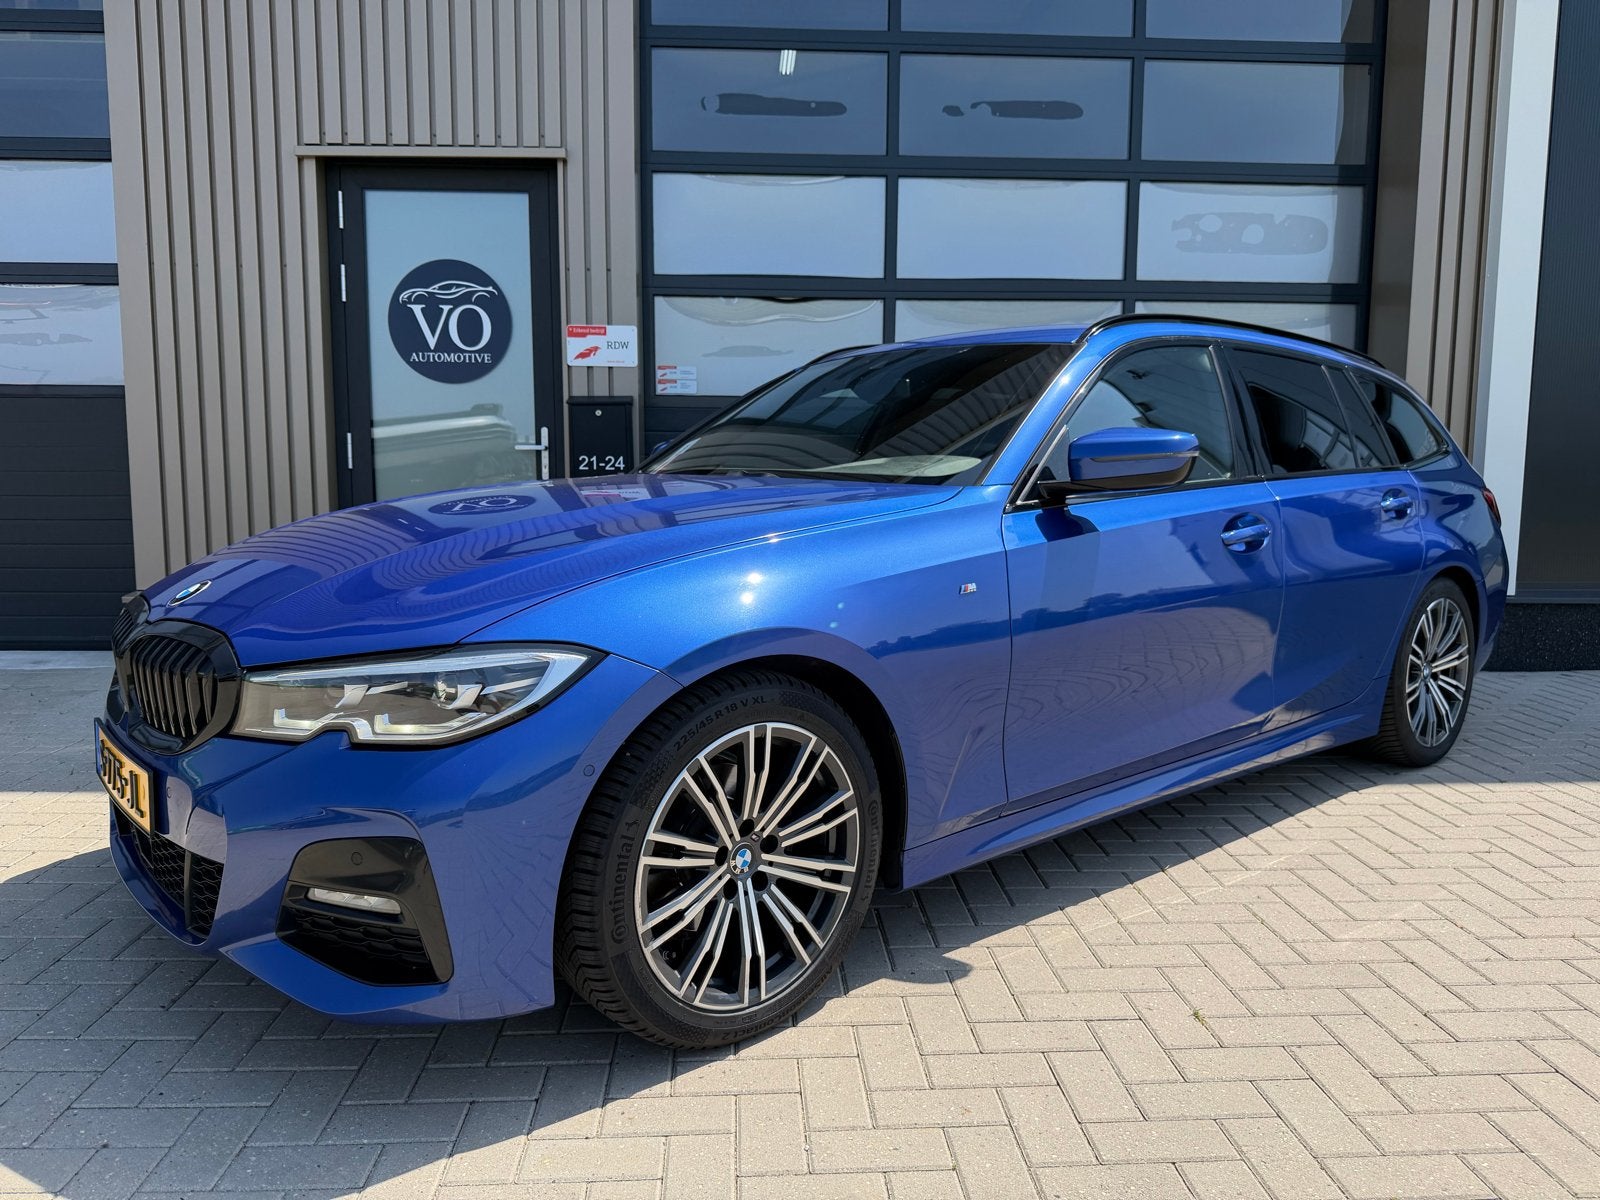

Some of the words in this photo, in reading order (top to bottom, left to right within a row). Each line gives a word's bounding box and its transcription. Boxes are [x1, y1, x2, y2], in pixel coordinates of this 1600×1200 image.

[407, 303, 492, 351] VO
[409, 352, 492, 364] AUTOMOTIVE
[606, 340, 630, 350] RDW
[578, 455, 626, 471] 21-24
[673, 715, 715, 752] 225/45
[714, 709, 725, 720] R
[724, 702, 739, 715] 18
[740, 698, 749, 708] V
[751, 695, 768, 706] XL
[610, 833, 636, 944] Continental
